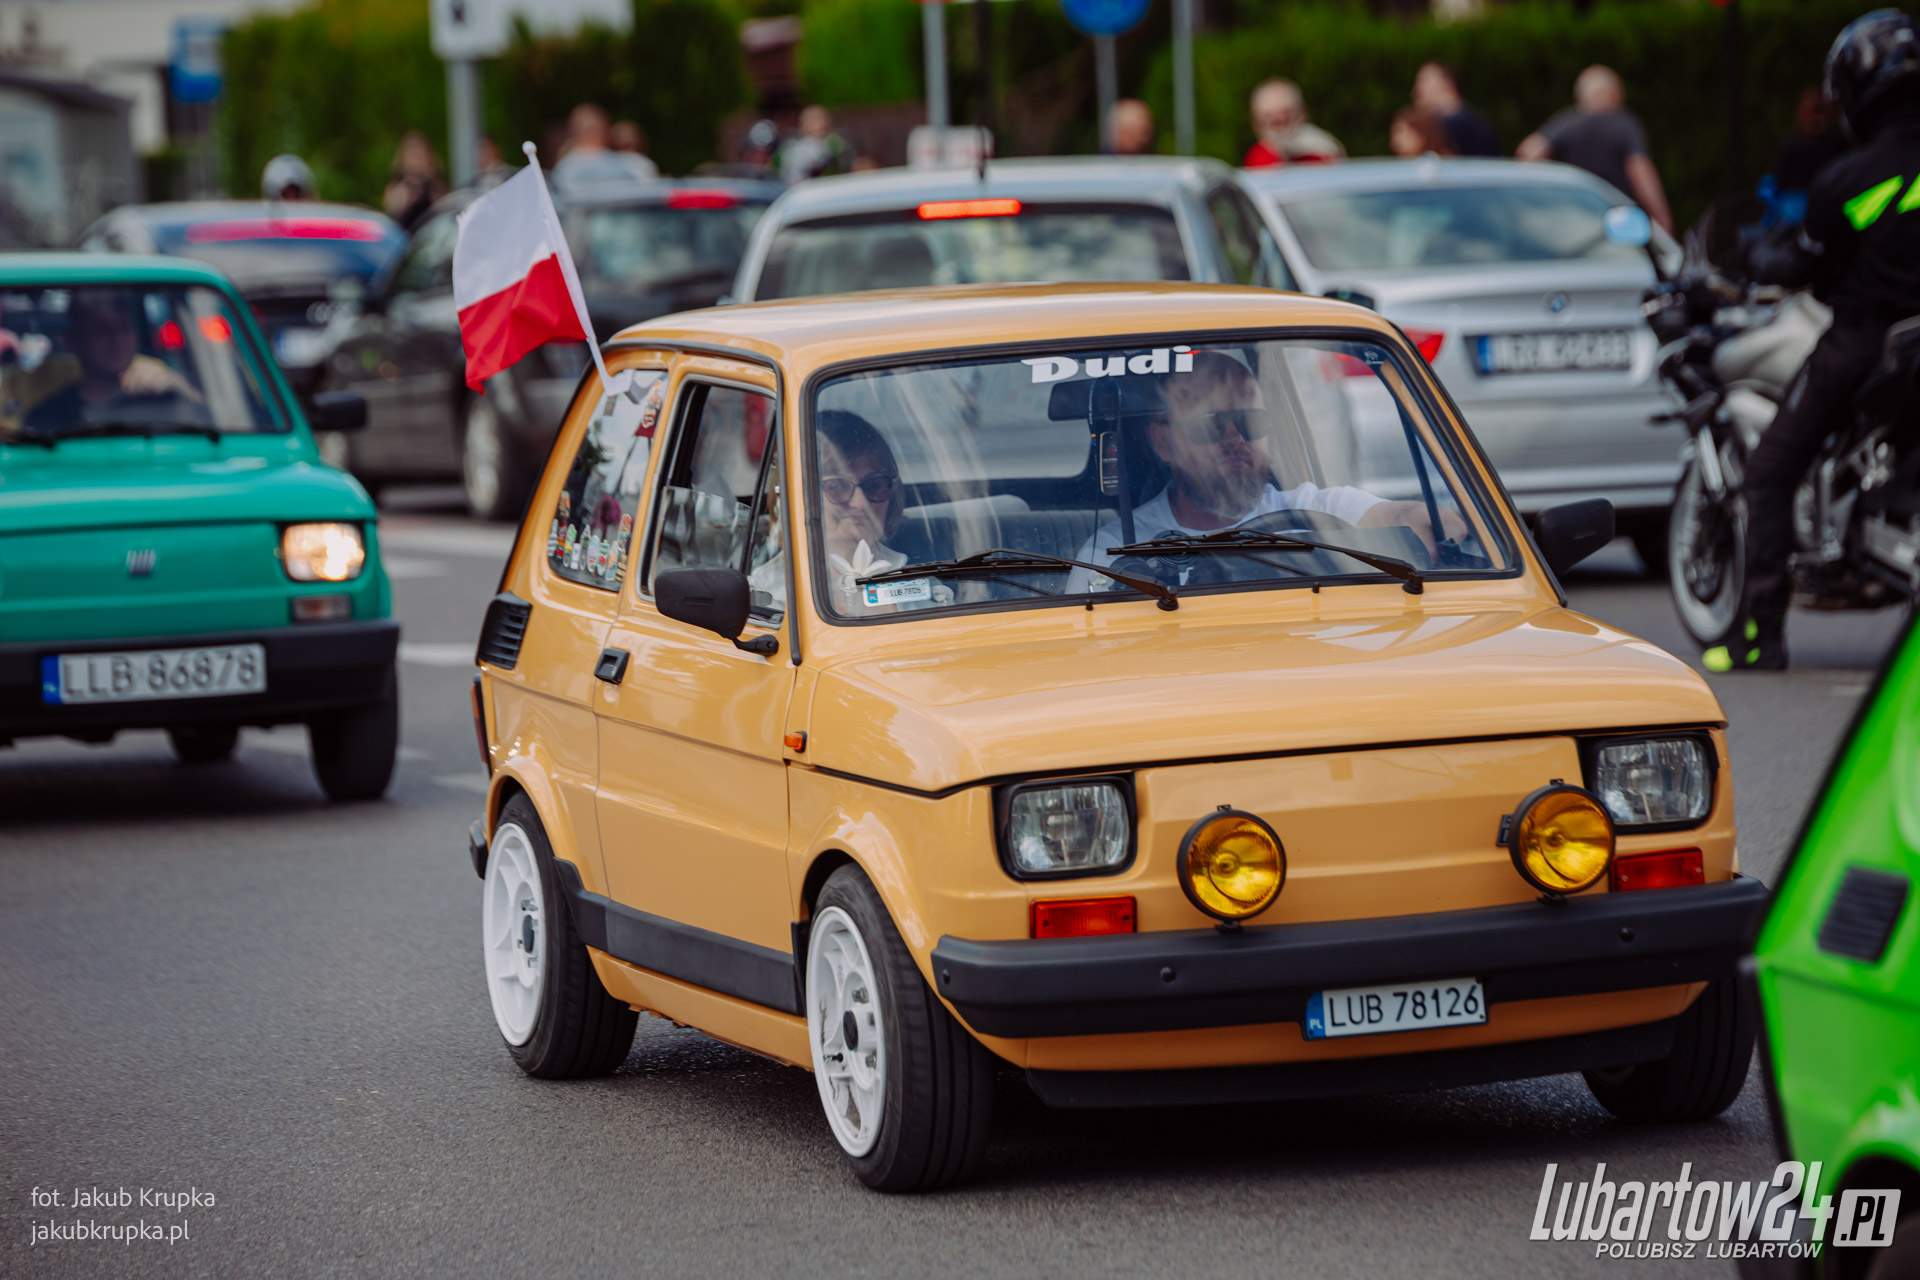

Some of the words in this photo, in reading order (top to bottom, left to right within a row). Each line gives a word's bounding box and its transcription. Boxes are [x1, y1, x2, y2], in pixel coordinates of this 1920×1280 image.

[1021, 345, 1194, 384] Dudi
[62, 656, 132, 695] LLB
[148, 647, 257, 690] 86878
[1328, 993, 1384, 1028] LUB
[1392, 984, 1480, 1023] 78126
